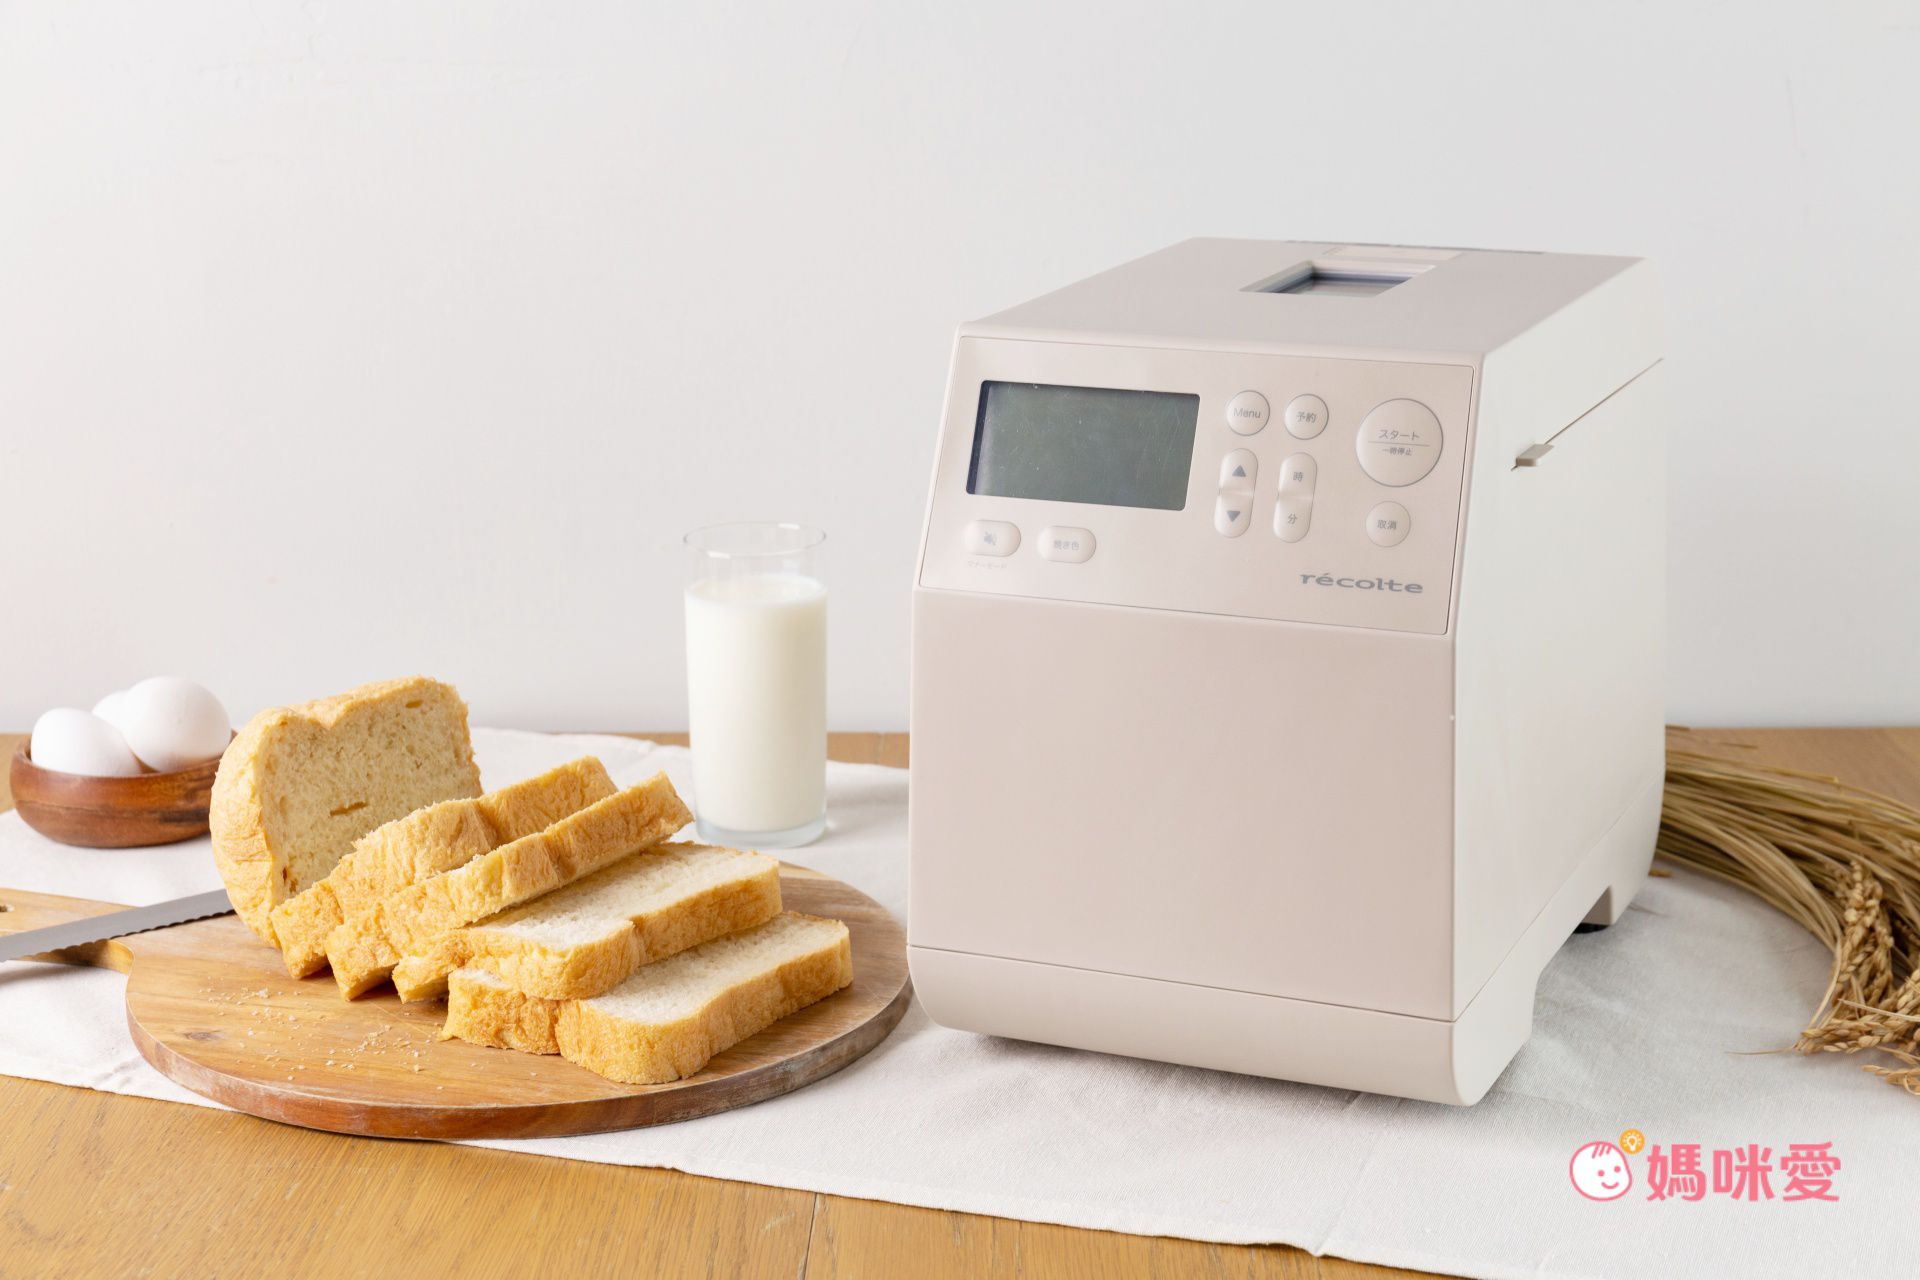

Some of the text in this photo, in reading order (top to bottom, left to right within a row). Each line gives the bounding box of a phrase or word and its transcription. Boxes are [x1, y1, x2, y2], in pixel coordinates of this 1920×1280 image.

[1233, 407, 1261, 419] Menu
[1296, 411, 1317, 423] 予約
[1378, 429, 1420, 441] スタート
[1293, 471, 1304, 482] 時
[1287, 513, 1298, 524] 分
[1377, 519, 1397, 530] 取消
[1300, 573, 1424, 594] récolte
